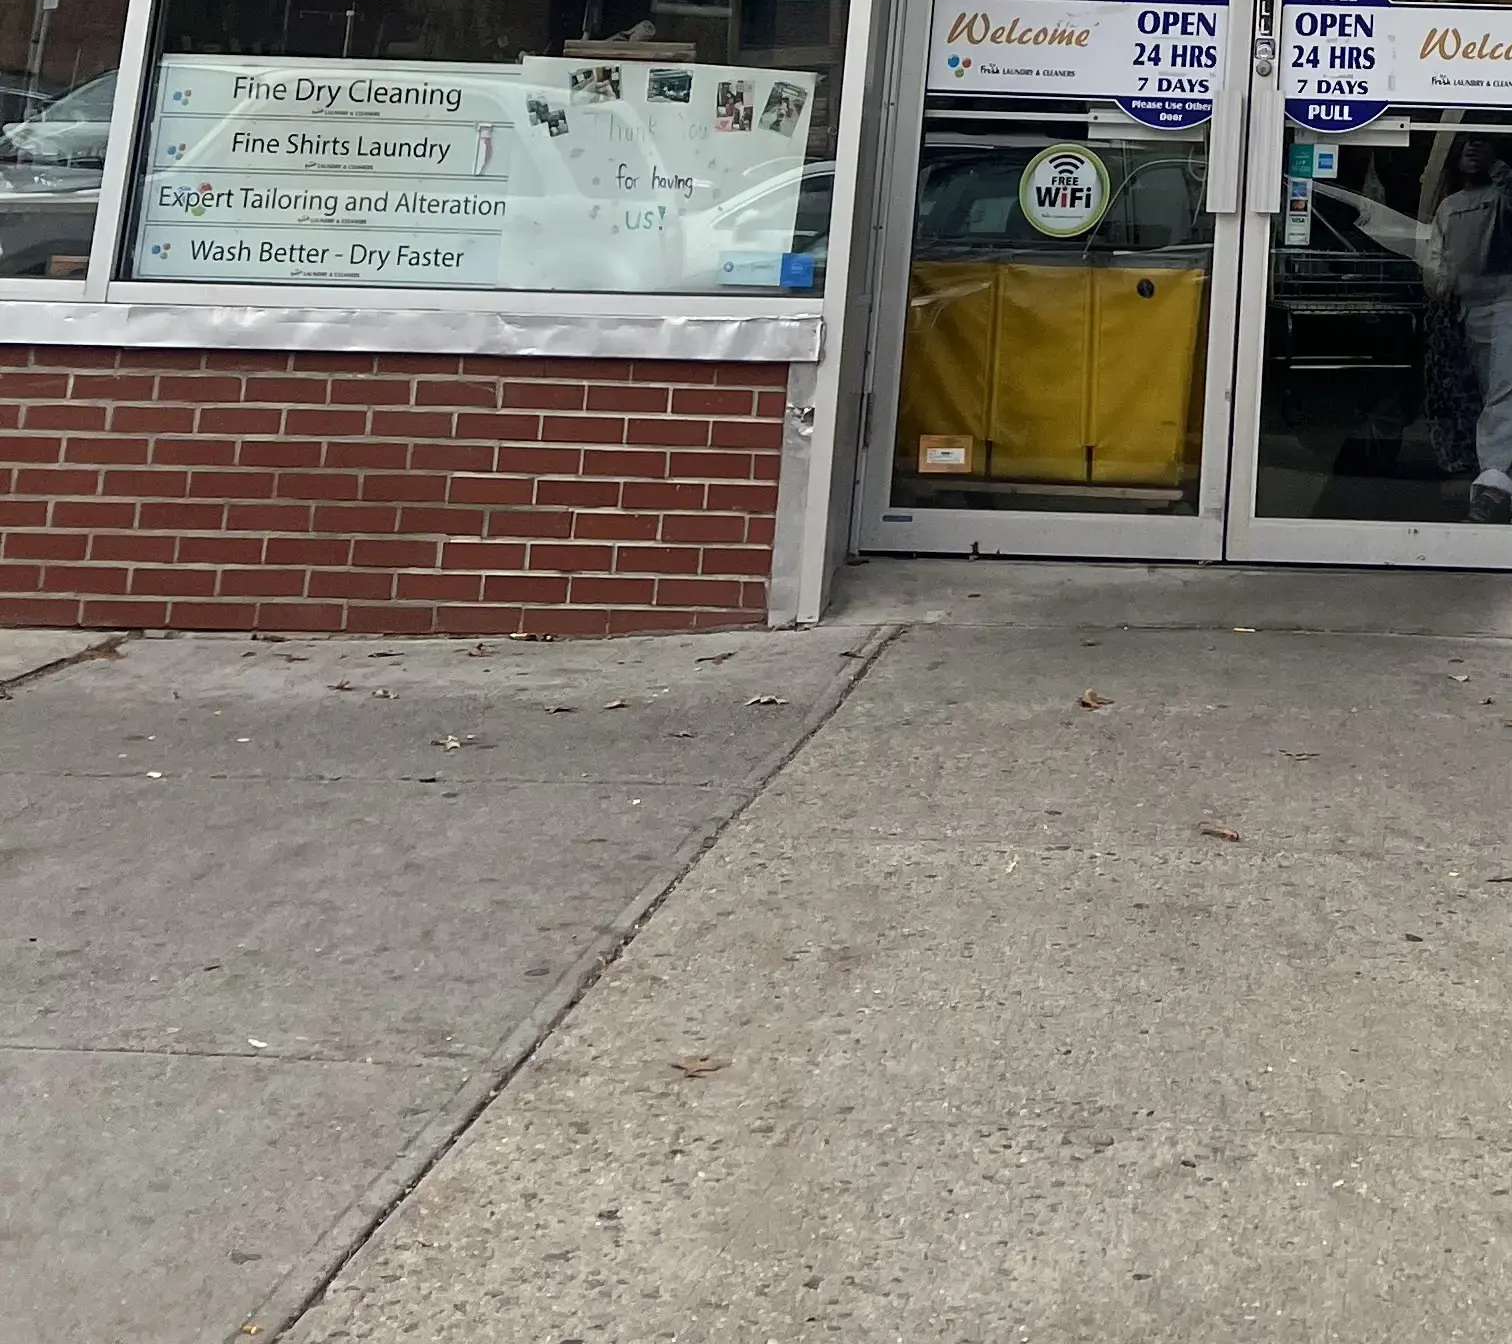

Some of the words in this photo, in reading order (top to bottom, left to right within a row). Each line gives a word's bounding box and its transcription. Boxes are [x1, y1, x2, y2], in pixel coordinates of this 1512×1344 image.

[947, 11, 1091, 47] Welcome
[1137, 10, 1217, 37] OPEN
[1295, 12, 1374, 38] OPEN
[1132, 42, 1162, 67] 24
[1170, 44, 1217, 69] HRS
[1291, 45, 1320, 69] 24
[1329, 45, 1376, 70] HRS
[233, 76, 287, 101] Fine
[295, 78, 342, 109] Dry
[348, 78, 463, 113] Cleaning
[1137, 77, 1149, 92] 7
[1157, 78, 1210, 94] DAYS
[1297, 79, 1308, 93] 7
[1316, 79, 1369, 95] DAYS
[1132, 100, 1163, 109] Please
[1165, 101, 1183, 110] Use
[1185, 101, 1212, 111] Other
[1159, 112, 1183, 122] Door
[1308, 104, 1352, 120] PULL
[231, 132, 280, 154] Fine
[285, 133, 350, 156] Shirts
[357, 135, 451, 165] Laundry
[616, 163, 640, 190] for
[652, 165, 694, 198] having
[1051, 176, 1079, 186] FREE
[158, 183, 235, 213] Expert
[239, 187, 338, 217] Tailoring
[345, 191, 389, 212] and
[394, 191, 506, 216] Alteration
[1036, 186, 1092, 209] WiFi
[626, 205, 667, 231] us!
[191, 239, 251, 262] Wash
[259, 241, 330, 264] Better
[349, 243, 391, 272] Dry
[396, 245, 465, 268] Faster
